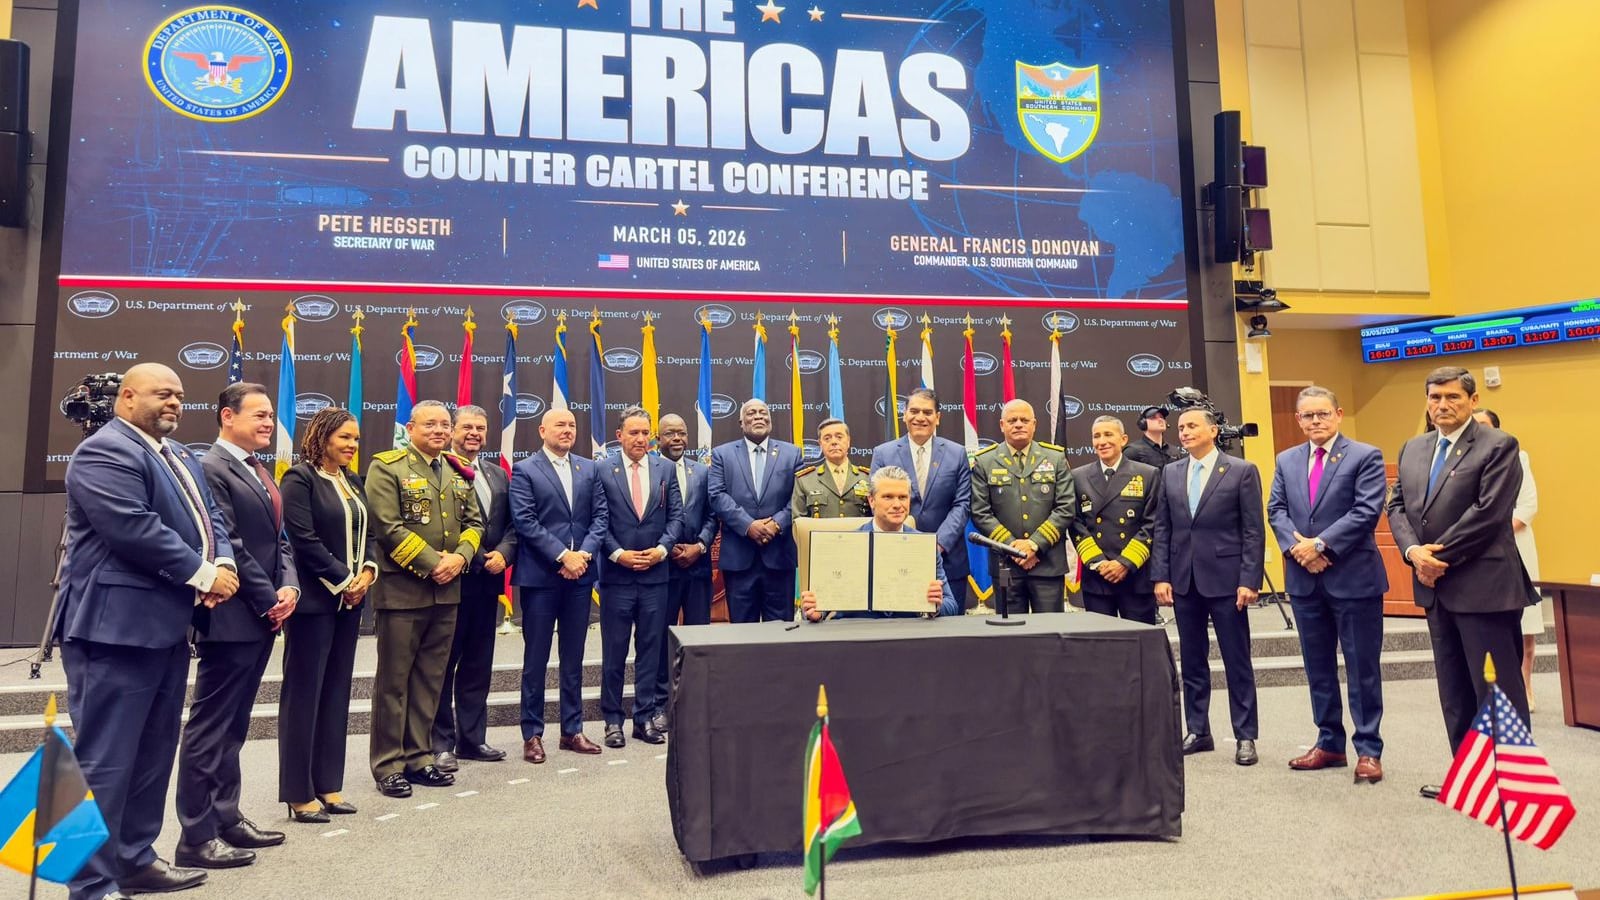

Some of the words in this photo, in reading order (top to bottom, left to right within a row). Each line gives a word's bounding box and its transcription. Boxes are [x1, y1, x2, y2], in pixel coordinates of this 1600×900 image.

[152, 10, 242, 50] DEPARTMENT
[244, 16, 263, 30] OF
[263, 29, 285, 57] WAR
[352, 16, 970, 161] AMERICAS
[156, 79, 185, 108] UNITED
[186, 102, 222, 116] STATES
[242, 86, 278, 113] AMERICA
[403, 144, 576, 186] COUNTER
[586, 154, 714, 192] CARTEL
[722, 162, 929, 200] CONFERENCE
[318, 214, 363, 232] PETE
[370, 216, 450, 236] HEGSETH
[614, 226, 670, 244] MARCH
[678, 228, 701, 246] 05,
[708, 230, 746, 246] 2026
[334, 236, 392, 249] SECRETARY
[395, 238, 408, 249] OF
[411, 238, 435, 250] WAR
[891, 235, 957, 253] GENERAL
[964, 238, 1025, 254] FRANCIS
[1032, 239, 1099, 256] DONOVAN
[637, 257, 669, 268] UNITED
[672, 258, 703, 269] STATES
[706, 259, 718, 270] OF
[720, 260, 760, 271] AMERICA
[972, 257, 988, 267] U.S.
[991, 257, 1033, 268] SOUTHERN
[1036, 259, 1078, 269] COMMAND
[126, 301, 145, 309] U.S.
[148, 301, 214, 311] Department
[217, 302, 227, 312] of
[432, 306, 441, 316] of
[552, 309, 568, 317] US.
[571, 309, 629, 319] Deptment
[631, 310, 640, 320] of
[814, 314, 822, 323] of
[933, 316, 983, 326] Departent
[986, 317, 994, 326] of
[1100, 319, 1149, 328] Department
[1151, 320, 1159, 328] of
[1564, 318, 1600, 326] HONDURA
[1520, 322, 1559, 332] CUBA/HAITI
[1568, 326, 1600, 336] 10:07
[1484, 336, 1514, 346] 13:07
[1525, 331, 1556, 342] 11:07
[1406, 345, 1434, 356] 11:07
[1444, 340, 1473, 351] 11:07
[102, 351, 112, 361] of
[114, 351, 138, 359] War
[256, 352, 321, 363] Depament
[323, 353, 334, 363] of
[470, 355, 530, 364] Departent
[533, 355, 542, 364] of
[1370, 350, 1397, 359] 16:07
[724, 357, 733, 366] of
[848, 359, 900, 368] Departmt
[902, 360, 910, 368] of
[1071, 361, 1079, 369] of
[816, 403, 824, 412] of
[989, 404, 997, 412] of
[1075, 447, 1083, 456] of
